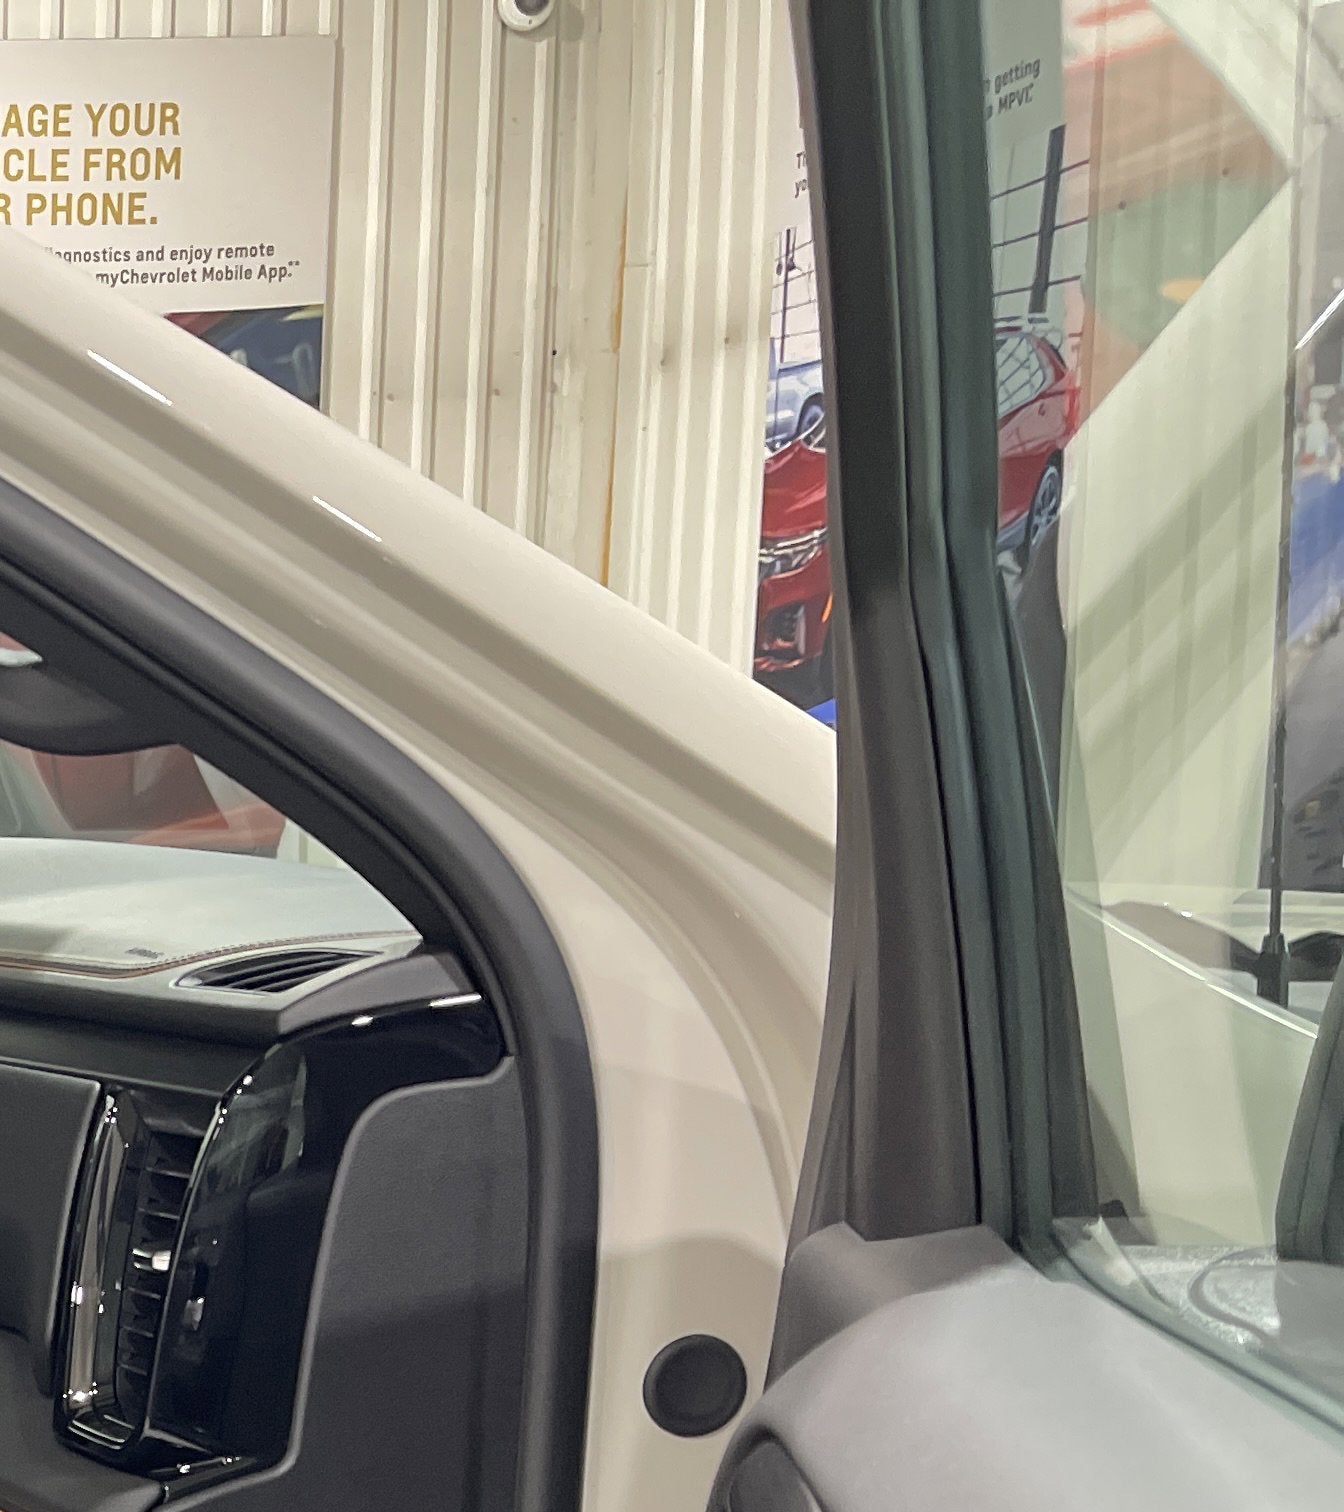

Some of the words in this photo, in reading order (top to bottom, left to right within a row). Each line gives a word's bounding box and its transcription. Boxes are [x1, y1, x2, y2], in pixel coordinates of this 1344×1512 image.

[995, 58, 1041, 94] getting
[85, 102, 180, 137] YOUR
[84, 146, 182, 182] FROM
[26, 191, 158, 226] PHONE.
[136, 244, 165, 262] and
[170, 244, 212, 265] enjoy
[217, 242, 275, 259] remote
[95, 266, 197, 288] myChevrolet
[202, 264, 253, 282] Mobile
